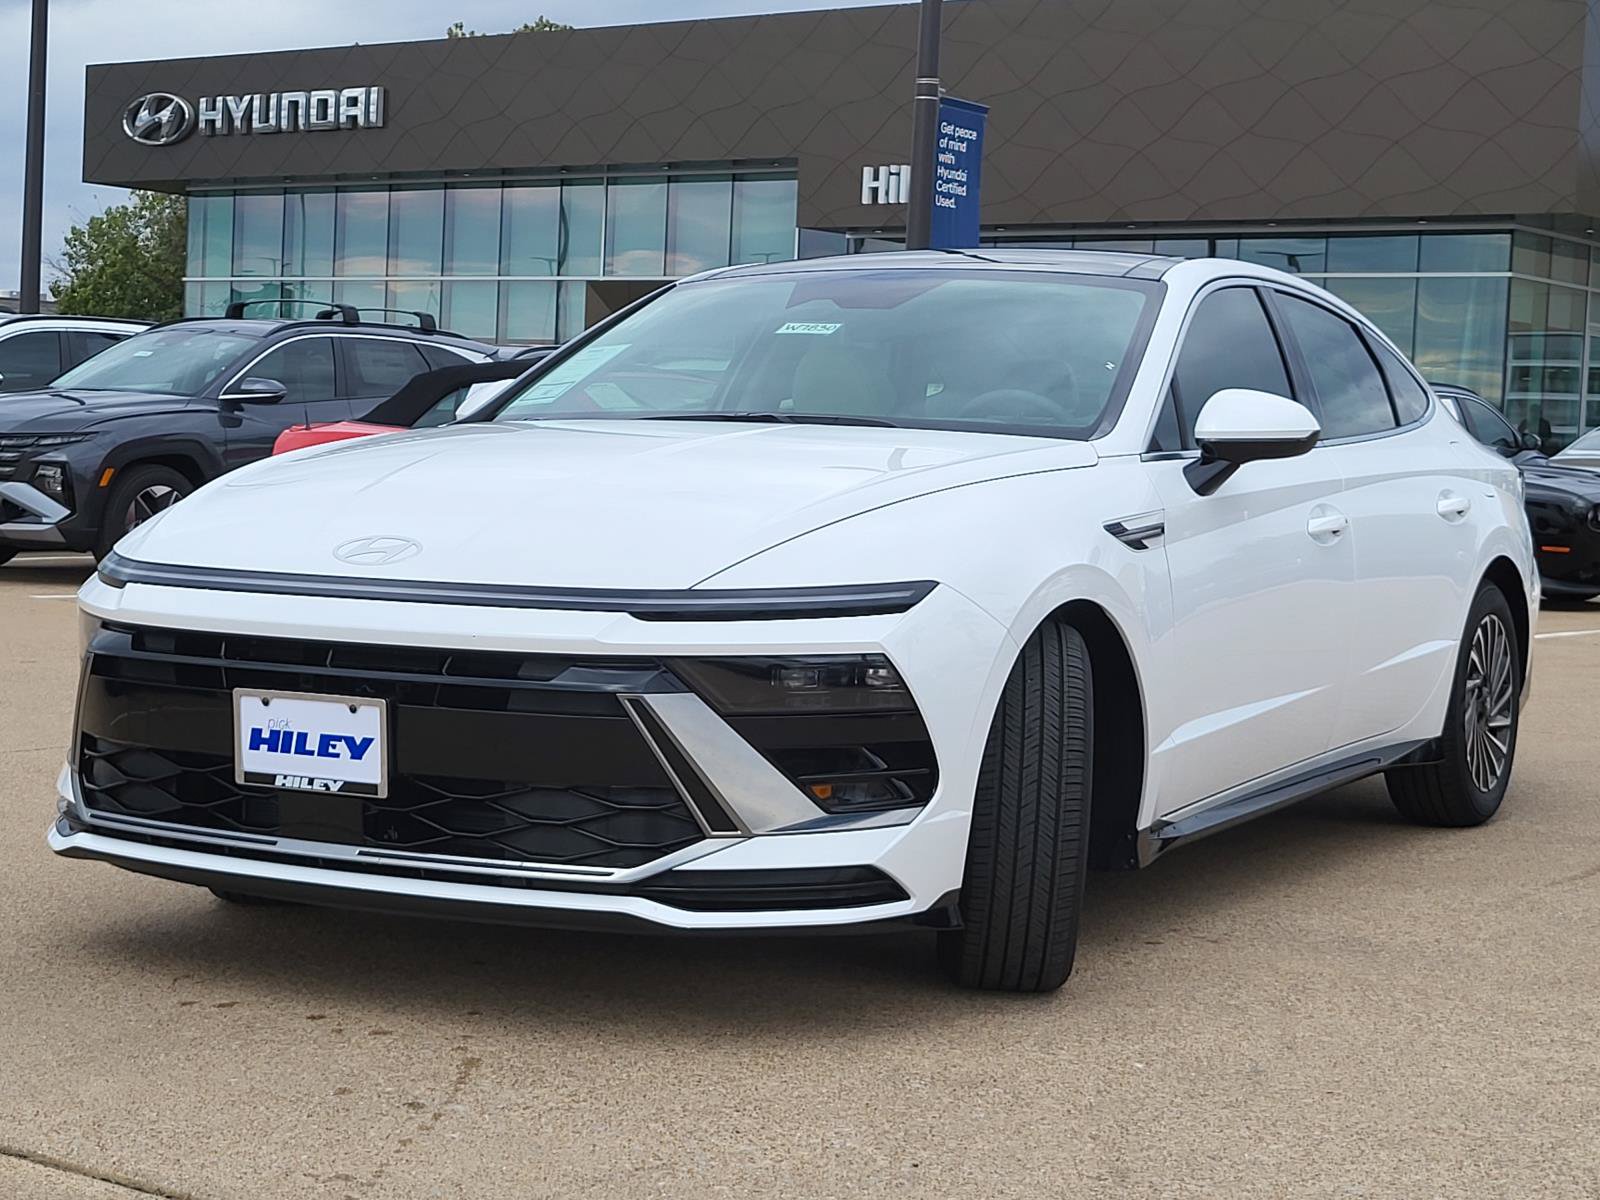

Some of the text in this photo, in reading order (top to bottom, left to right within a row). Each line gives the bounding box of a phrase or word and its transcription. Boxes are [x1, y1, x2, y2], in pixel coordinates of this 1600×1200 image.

[199, 86, 384, 136] HYUNDAI
[940, 122, 977, 140] Get peace
[939, 137, 967, 153] of mind
[938, 151, 955, 165] with
[937, 165, 968, 181] Hyundai
[936, 180, 967, 196] Certified
[935, 194, 957, 208] Used.
[267, 717, 291, 731] pick
[248, 727, 375, 761] HILEY
[274, 774, 345, 792] HILEY
